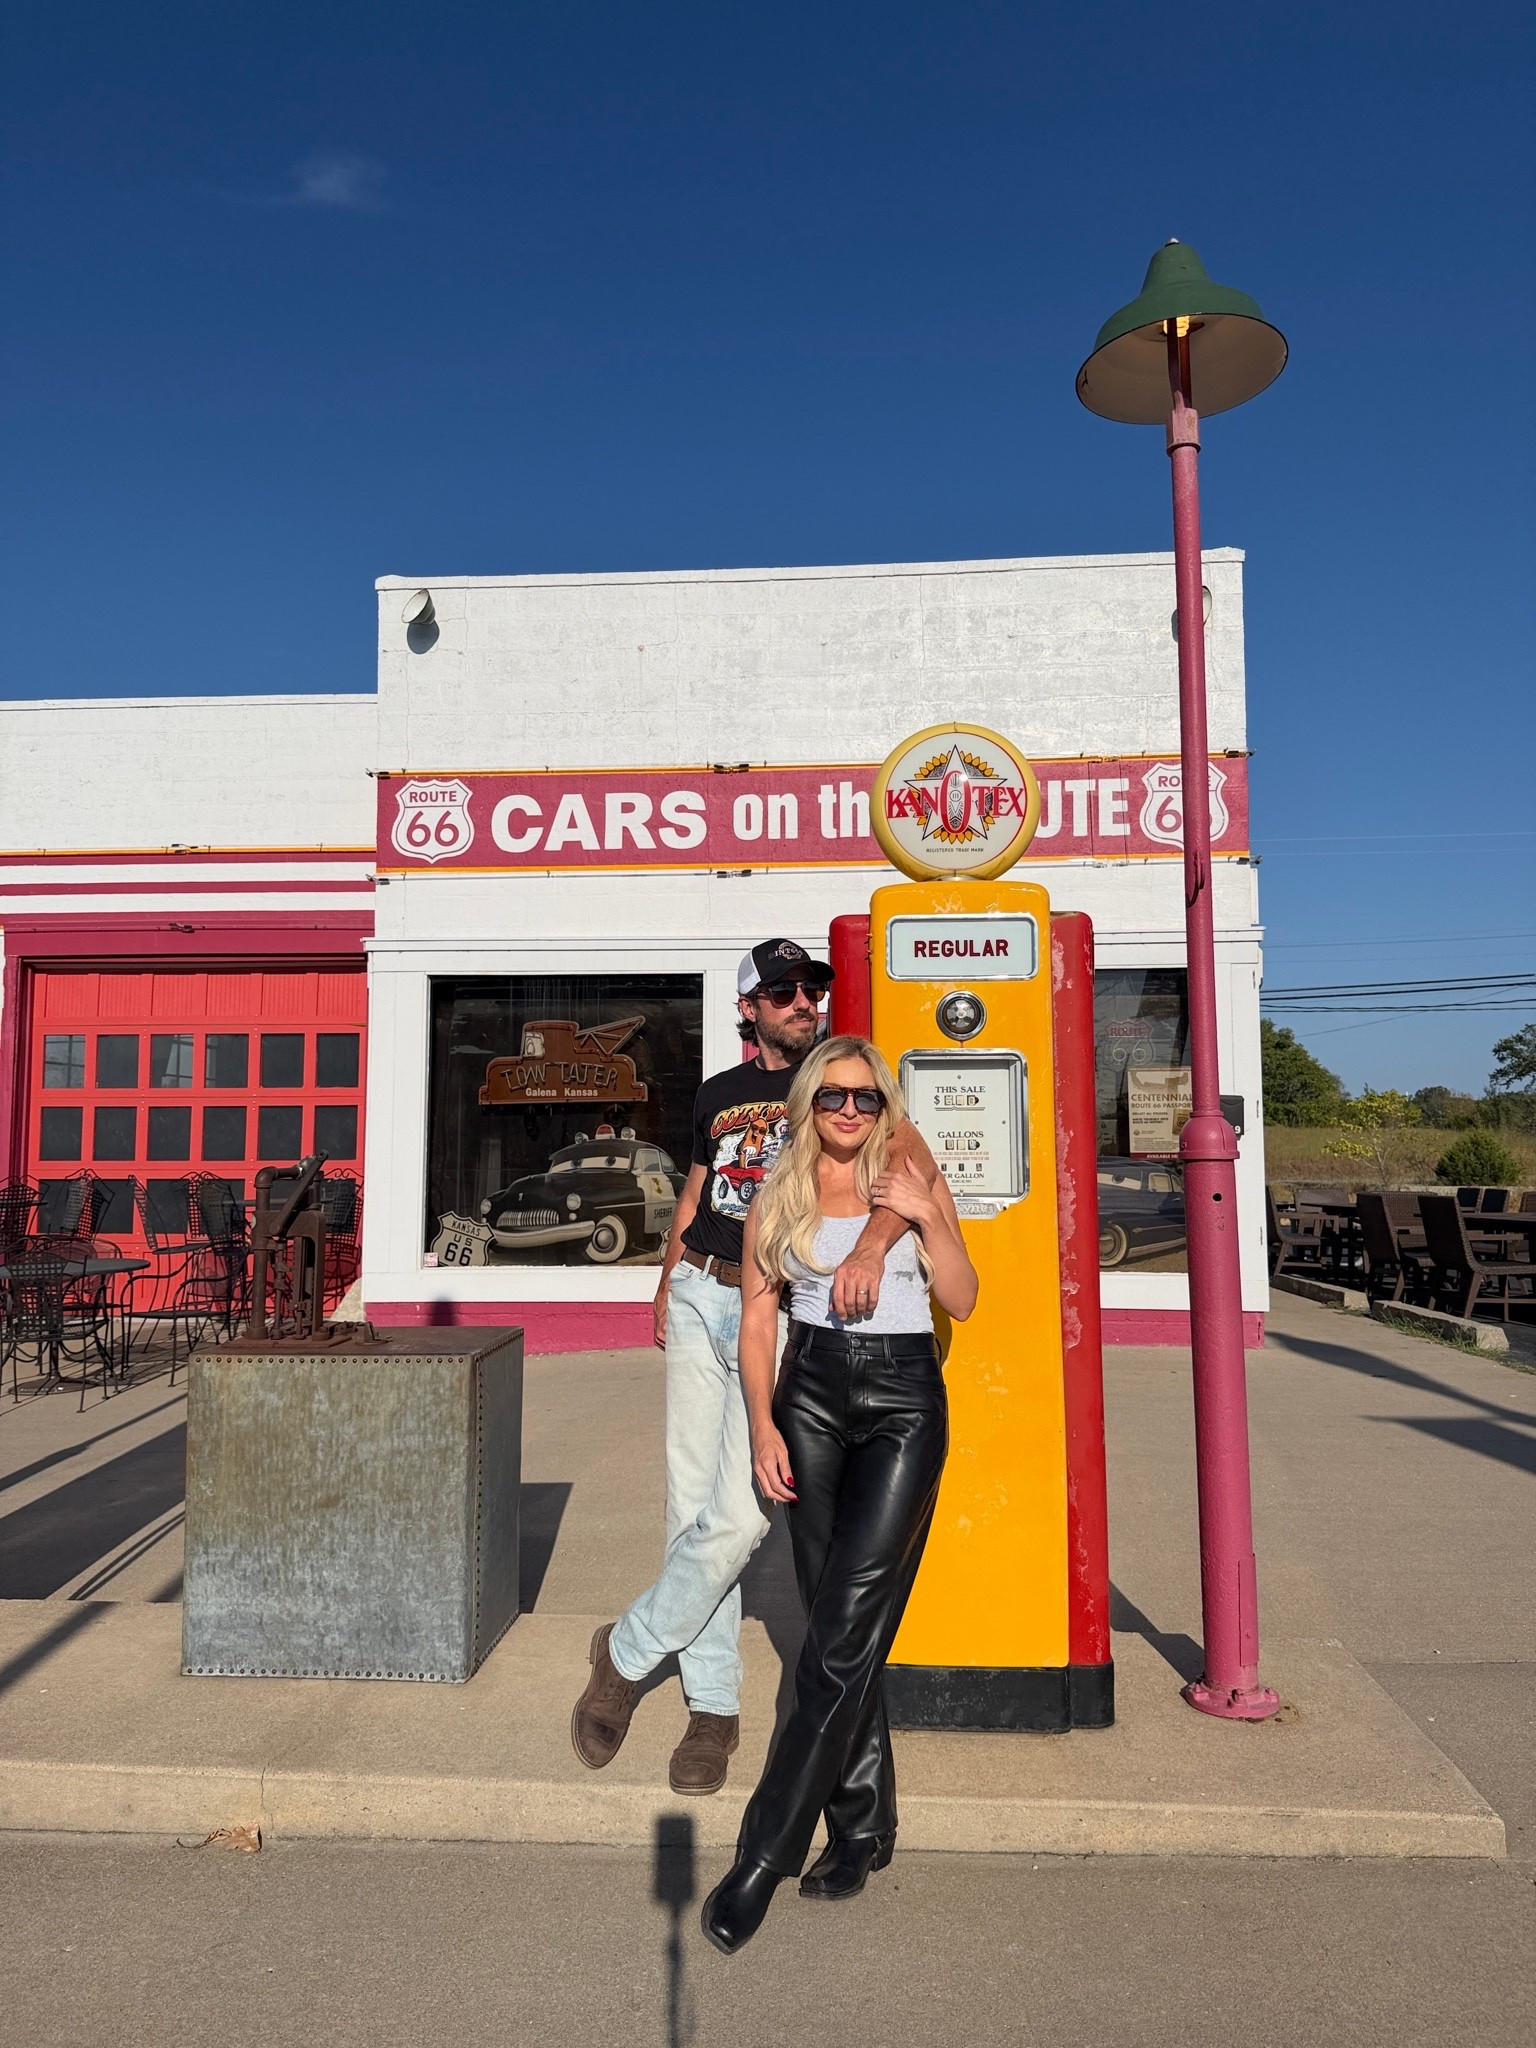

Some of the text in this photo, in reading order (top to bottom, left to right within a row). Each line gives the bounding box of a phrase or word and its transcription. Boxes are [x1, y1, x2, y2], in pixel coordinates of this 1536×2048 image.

[409, 790, 458, 803] ROUTE
[490, 777, 1131, 854] CARS on th UTE
[406, 810, 460, 848] 66
[913, 939, 1009, 958] REGULAR
[1110, 1026, 1147, 1037] ROUTE
[1112, 1039, 1147, 1063] 66
[500, 1061, 618, 1090] TOW TATER
[525, 1088, 599, 1097] Galena Kansas
[933, 1094, 941, 1106] $
[1131, 1093, 1193, 1102] CENTENNIAL
[711, 1101, 766, 1138] COZY
[937, 1131, 984, 1139] GALLONS
[653, 1207, 673, 1219] SHERIFF
[451, 1220, 482, 1237] KANSAS
[444, 1242, 473, 1266] 66
